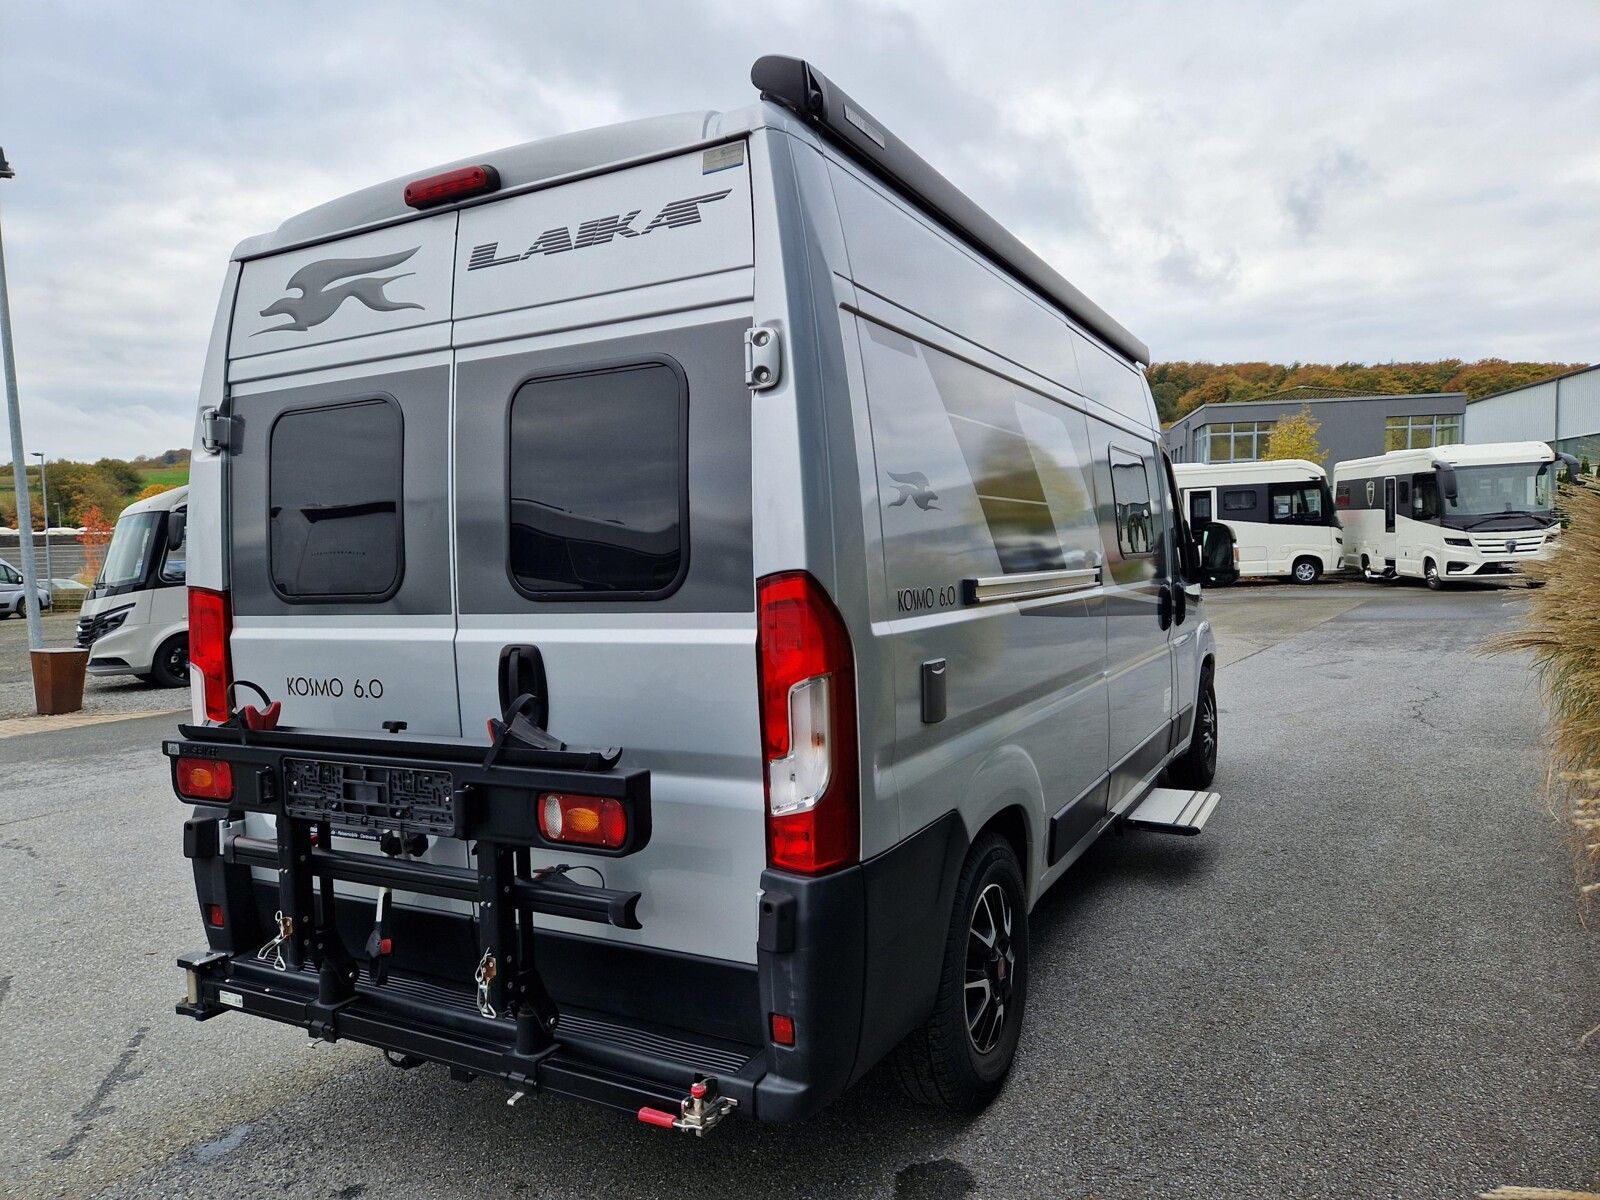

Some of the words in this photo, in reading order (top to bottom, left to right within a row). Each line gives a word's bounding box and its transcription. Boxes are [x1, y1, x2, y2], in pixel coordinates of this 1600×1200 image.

[467, 188, 733, 272] LAIKA
[897, 587, 934, 612] KOSMO
[940, 585, 956, 607] 6.0
[286, 677, 343, 697] KOSMO
[353, 679, 384, 699] 6.0
